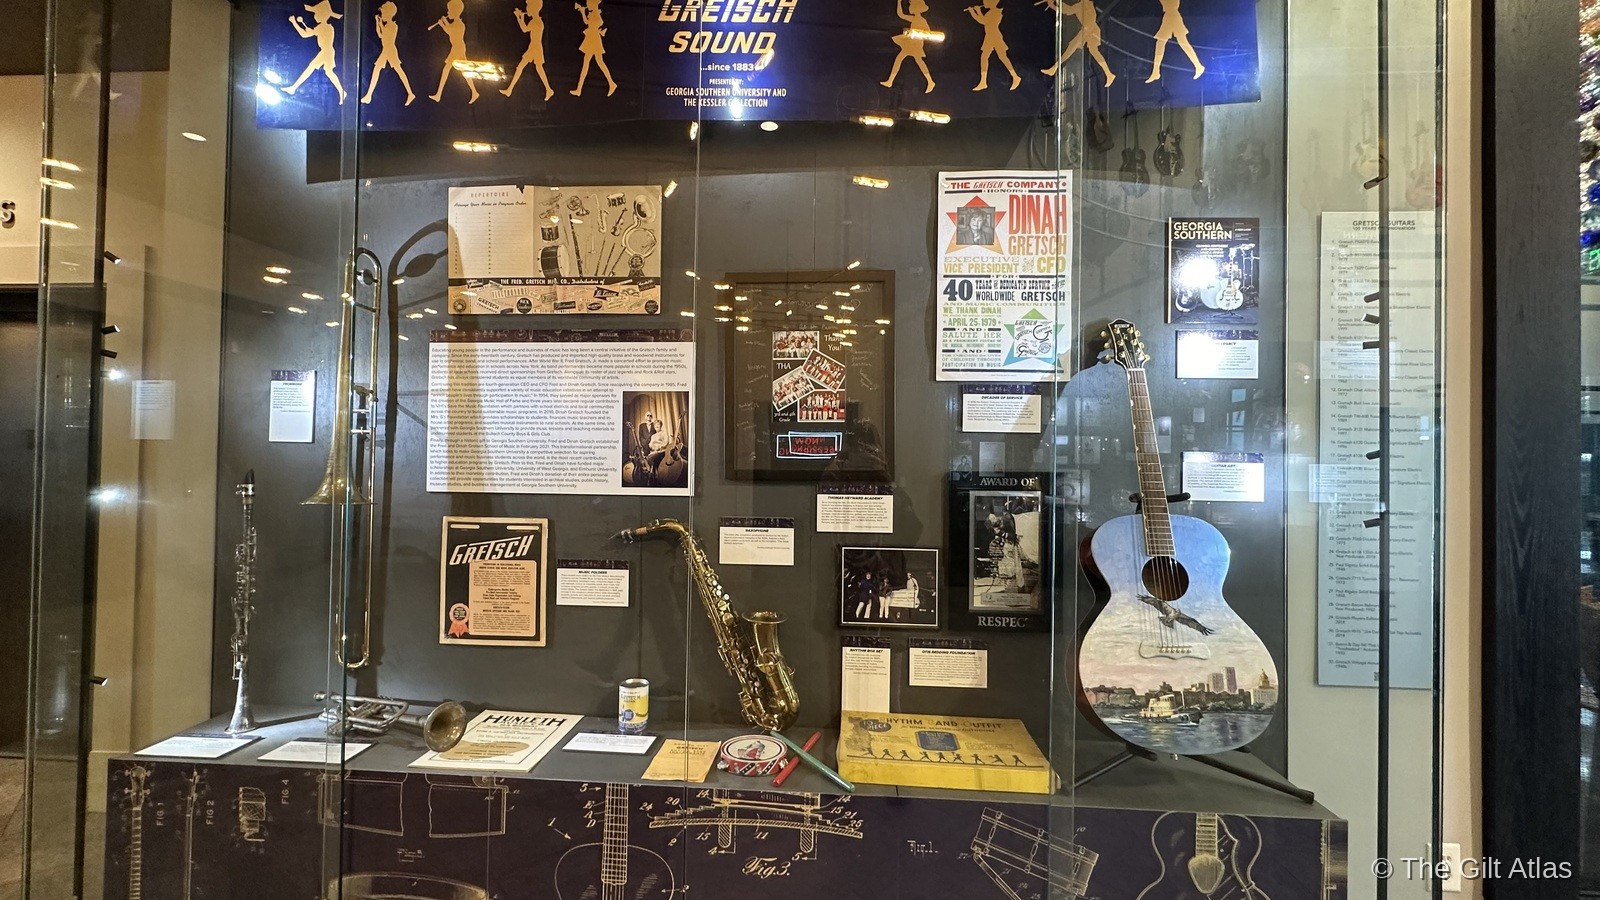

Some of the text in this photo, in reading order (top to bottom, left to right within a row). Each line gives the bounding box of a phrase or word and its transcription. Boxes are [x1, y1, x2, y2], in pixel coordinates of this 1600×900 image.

[669, 31, 776, 53] SOUND
[666, 88, 694, 96] GEORGIA
[696, 88, 730, 96] SOUTHERN
[1009, 194, 1067, 234] DINAH
[1174, 222, 1223, 231] GEORGIA
[1174, 231, 1232, 240] SOUTHERN
[1008, 235, 1067, 256] GRETSCH
[944, 257, 1066, 273] VICE PRESIDENT CFO
[943, 279, 973, 301] 40
[976, 280, 992, 289] YEARS
[1000, 280, 1026, 289] DEDICATED
[1029, 280, 1050, 289] SERVICE
[976, 291, 1065, 301] WORLDWIDE GRETSCH
[948, 318, 968, 326] APRIL
[980, 477, 1034, 486] AWARD OF
[450, 535, 534, 565] GRETSCH
[978, 616, 1028, 627] RESPEC
[482, 715, 566, 726] HUNLETH
